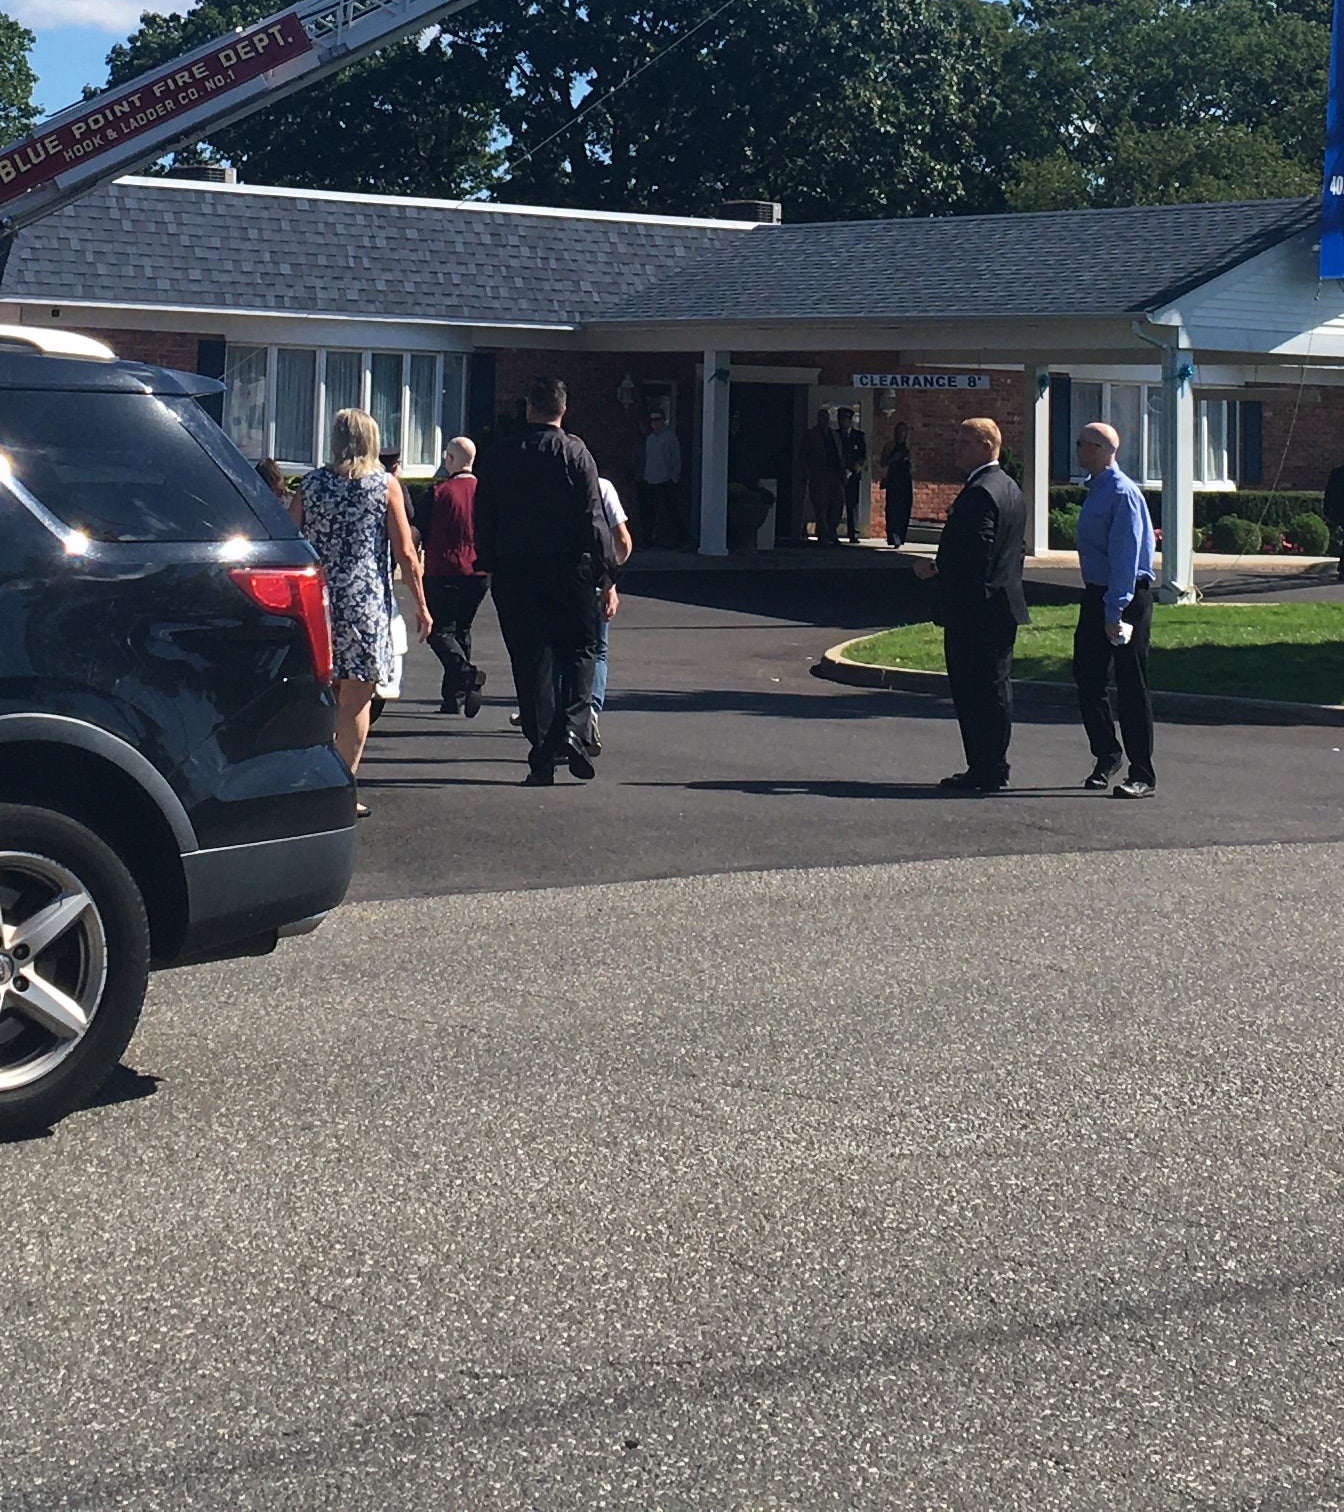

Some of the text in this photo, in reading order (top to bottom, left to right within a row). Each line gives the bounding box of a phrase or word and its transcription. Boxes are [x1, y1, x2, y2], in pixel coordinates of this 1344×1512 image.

[71, 93, 142, 139] POINT
[152, 62, 209, 97] FIRE
[218, 24, 293, 68] DEPT.
[63, 135, 105, 162] HOOK
[106, 129, 119, 141] &
[120, 99, 177, 134] LADDER
[178, 88, 204, 105] CO.
[858, 374, 958, 388] CLEARANCE
